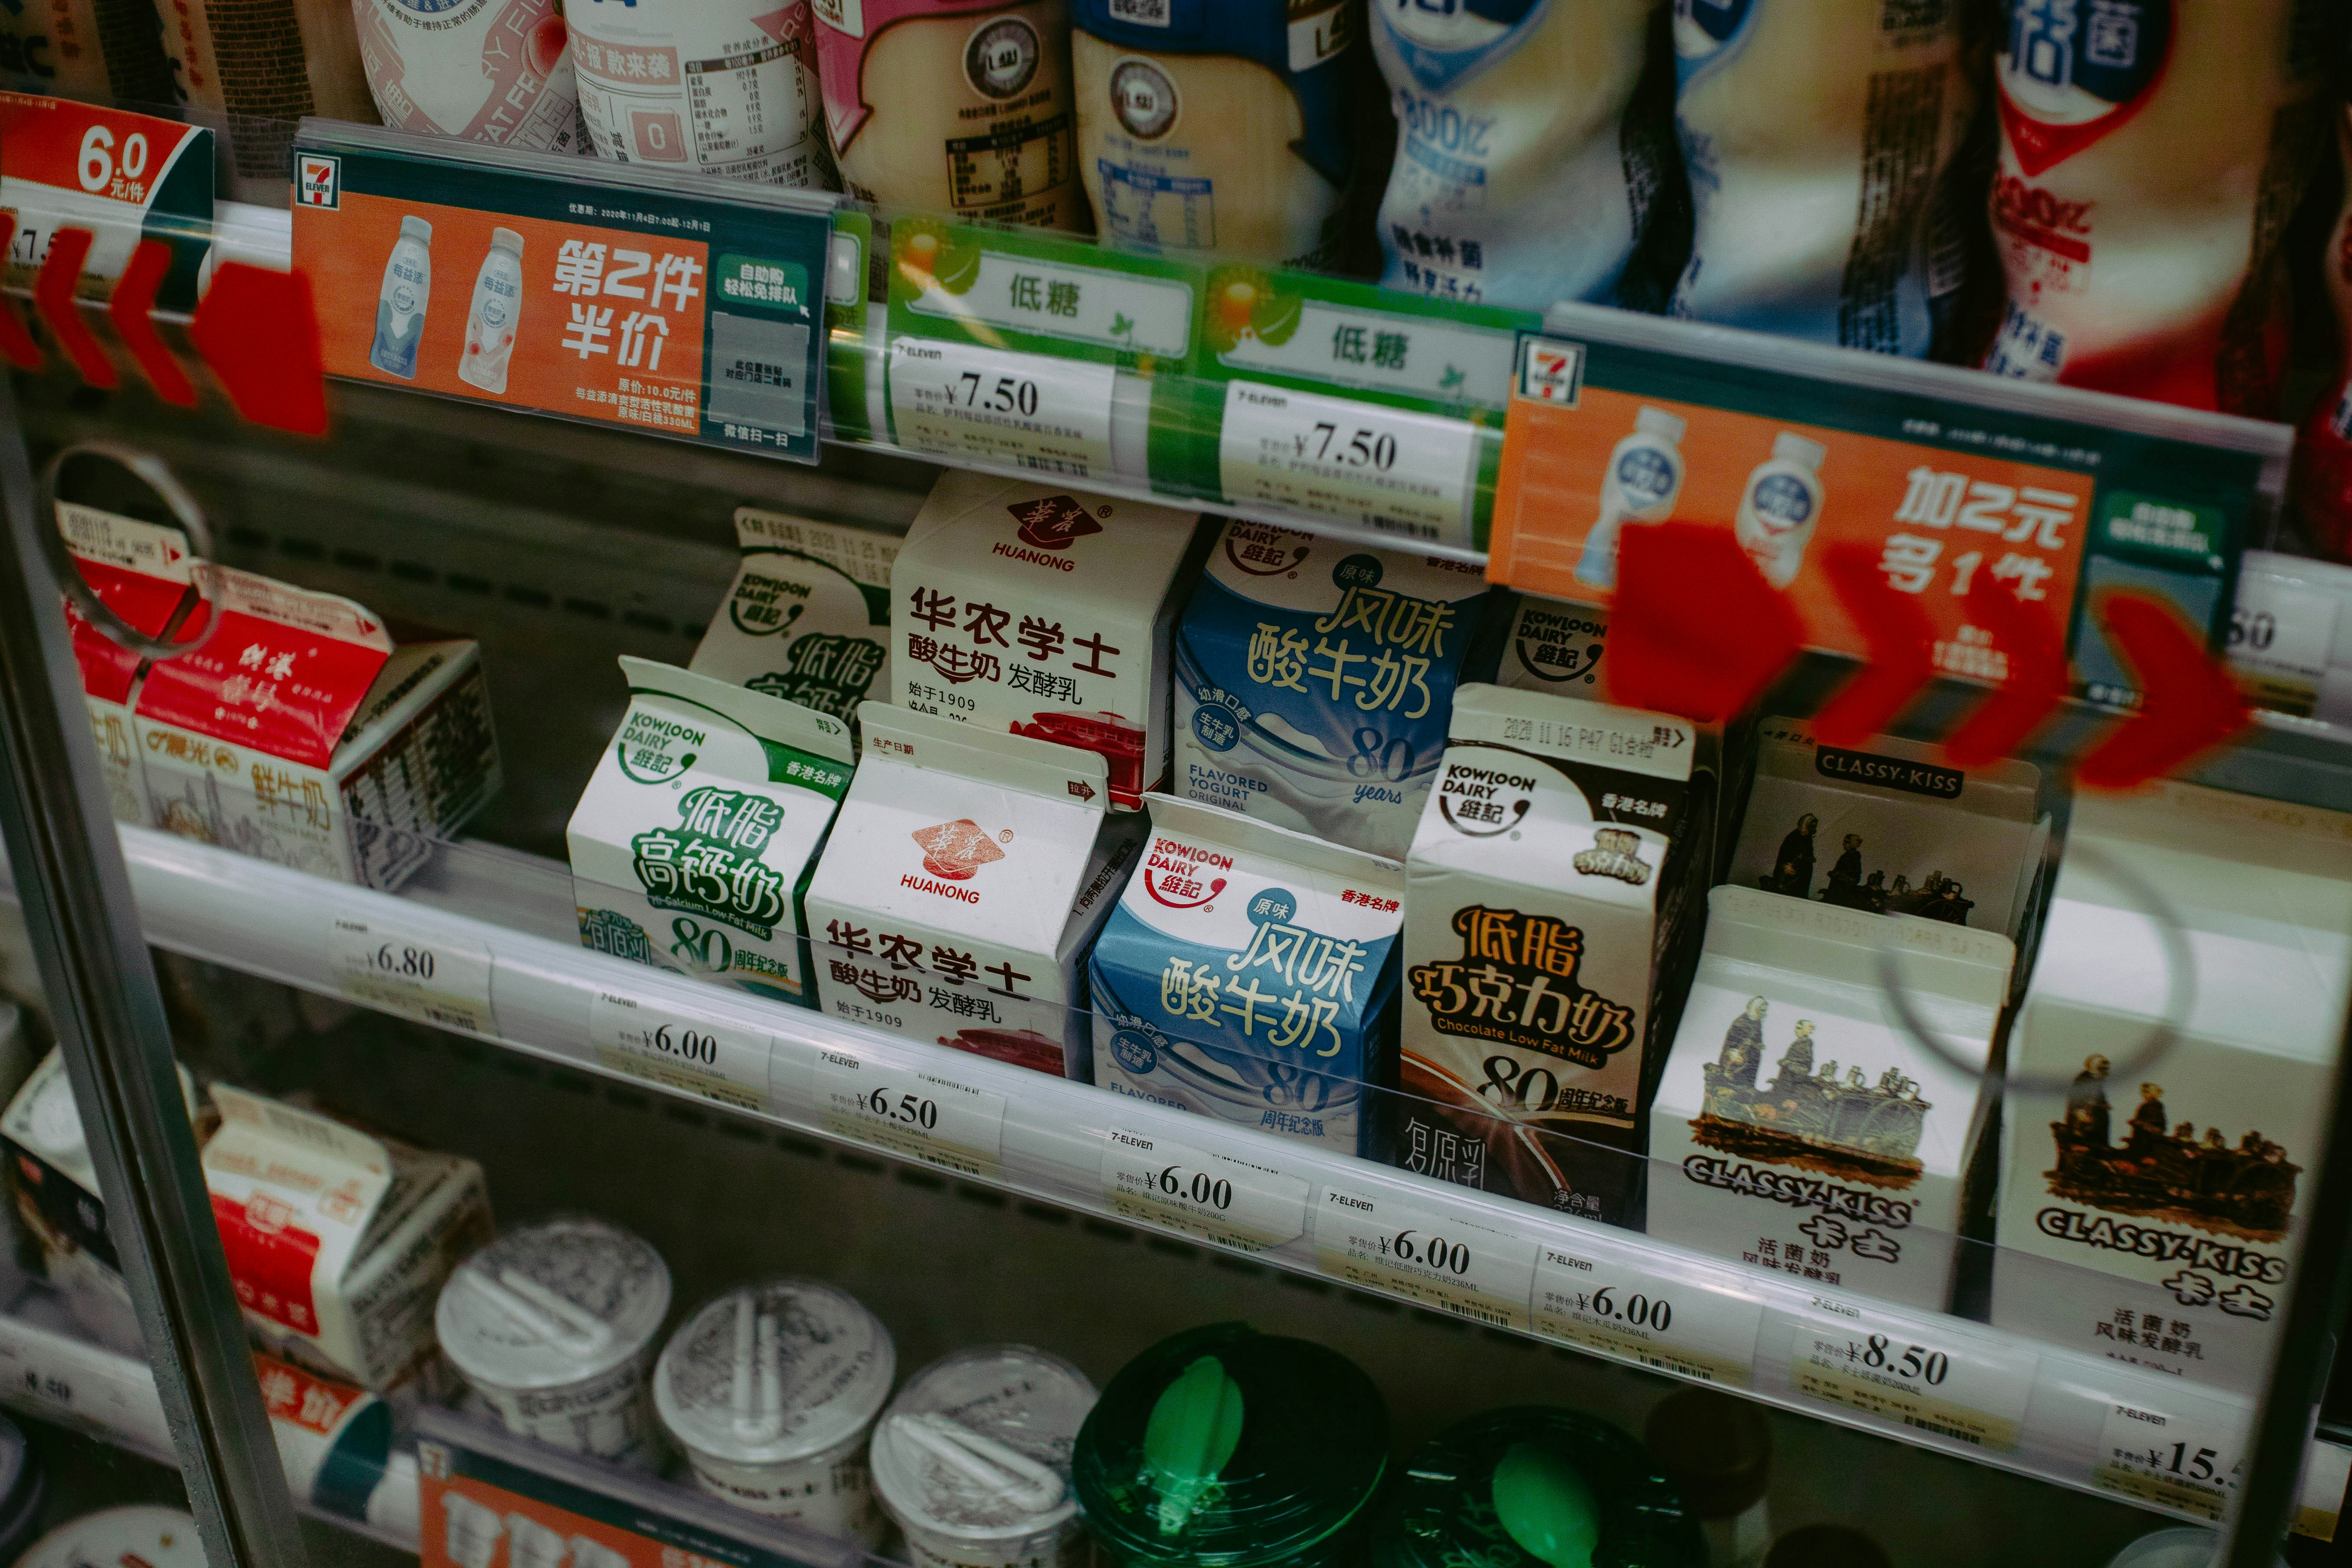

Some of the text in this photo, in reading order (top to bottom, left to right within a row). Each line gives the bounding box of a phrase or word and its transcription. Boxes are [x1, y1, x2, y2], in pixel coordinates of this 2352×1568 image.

[78, 125, 147, 192] 6.0
[111, 178, 144, 202] 元/件
[394, 264, 424, 284] 每益添
[483, 276, 515, 297] 每益添
[553, 240, 703, 312] 第2件
[740, 264, 784, 287] 自助购
[725, 278, 797, 305] 轻松免排队
[1009, 273, 1080, 318] 低糖
[562, 303, 669, 370] 半价
[1333, 325, 1409, 370] 低糖
[724, 424, 788, 447] 微信扫一扫
[1895, 466, 2078, 550] 加2元
[1229, 527, 1281, 545] DAIRY
[992, 542, 1075, 572] HUANONG
[1240, 545, 1286, 566] 維記
[1878, 532, 2052, 602] 多1件
[744, 573, 812, 598] KOWLOON
[1339, 565, 1375, 584] 原味
[910, 586, 1121, 678] 华农学士
[1315, 586, 1455, 657] 风味
[1518, 624, 1572, 645] DAIRY
[1522, 609, 1608, 638] KOWLOON
[794, 637, 879, 687] 低脂
[908, 633, 1082, 706] 酸牛奶 发酵乳
[1248, 622, 1430, 719] 酸牛奶
[1532, 644, 1579, 669] 維記
[908, 681, 975, 711] 始于1909
[1198, 686, 1251, 723] 幼滑口感
[623, 727, 671, 752] DAIRY
[630, 712, 706, 747] KOWLOON
[1199, 712, 1235, 739] 生牛乳
[1201, 724, 1226, 746] 制造
[630, 748, 673, 775] 維記
[873, 737, 915, 756] 生产日期
[1347, 727, 1415, 782] 80
[786, 761, 841, 788] 香港名牌
[1070, 781, 1091, 796] 拉开
[1189, 776, 1250, 800] YOGURT
[1190, 764, 1267, 793] FLAVORED
[1441, 780, 1498, 799] DAIRY
[1447, 764, 1535, 792] KOWLOON
[252, 763, 330, 831] 鲜牛奶
[1189, 789, 1246, 811] ORIGINAL
[1353, 783, 1402, 805] years
[1602, 793, 1667, 819] 香港名牌
[686, 790, 779, 849] 低脂
[1457, 800, 1505, 824] 維記
[1147, 854, 1200, 878] DAIRY
[1155, 838, 1233, 872] KOWLOON
[638, 831, 779, 919] 高钙奶
[900, 873, 980, 905] HUANONG
[1158, 875, 1204, 899] 維記
[1253, 897, 1289, 920] 原味
[1342, 889, 1399, 914] 香港名牌
[706, 905, 726, 920] Low
[728, 912, 745, 926] Fat
[746, 919, 769, 939] Milk
[671, 917, 788, 978] 80 周年纪念版
[1458, 909, 1578, 977] 低脂
[826, 918, 1032, 1001] 华农学士
[1228, 921, 1367, 1002] 风味
[829, 959, 1001, 1024] 酸牛奶 发酵乳
[1161, 957, 1341, 1057] 酸牛奶
[1414, 964, 1627, 1048] 巧克力奶
[836, 1000, 903, 1028] 始于1909
[1118, 1037, 1152, 1063] 生牛乳
[1437, 1017, 1599, 1065] Chocolate Low Fat Milk
[1120, 1049, 1145, 1068] 制造
[1263, 1062, 1330, 1111] 80
[1477, 1055, 1629, 1114] 80 周年纪念版
[856, 1088, 937, 1129] ¥6.50
[1261, 1111, 1326, 1137] 周年纪念版
[1117, 1166, 1232, 1209] 零售价 ¥6.00
[1554, 1189, 1600, 1210] 净含量
[1143, 1191, 1226, 1222] 维记原味酸牛奶200G
[1349, 1230, 1470, 1274] 零售价 ¥6.00
[1758, 1238, 1831, 1269] 活菌奶
[1799, 1214, 1900, 1264] 卡士
[1375, 1256, 1480, 1292] 维记低脂巧克力奶236ML
[1576, 1287, 1671, 1331] ¥6.00
[2163, 1270, 2274, 1321] 卡士
[2114, 1307, 2191, 1338] 活菌奶
[2095, 1321, 2204, 1359] 风味发酵乳
[1843, 1334, 1948, 1385] ¥8.50
